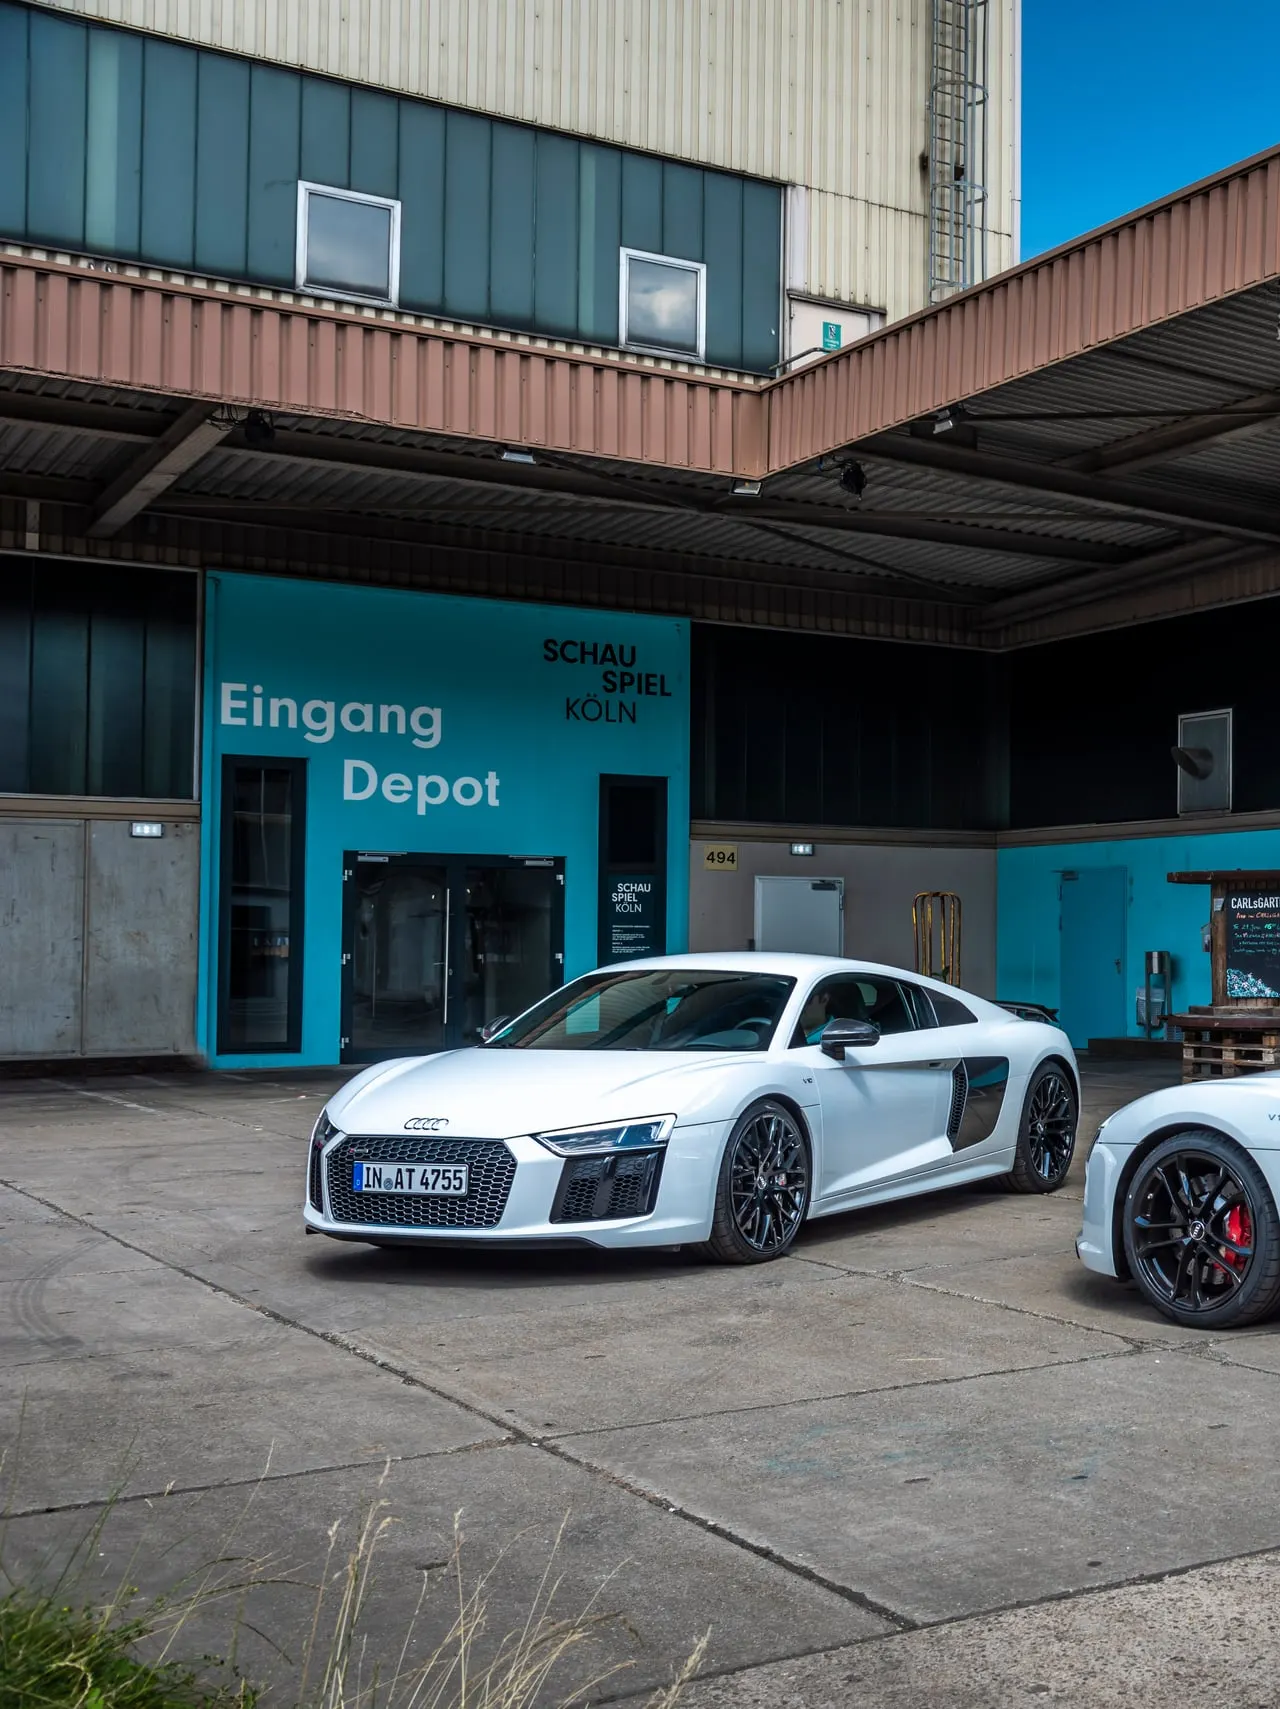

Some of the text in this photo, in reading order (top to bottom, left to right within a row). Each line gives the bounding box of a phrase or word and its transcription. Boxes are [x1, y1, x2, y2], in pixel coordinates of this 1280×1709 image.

[543, 638, 636, 668] SCHAU
[602, 670, 672, 697] SPIEL
[220, 682, 442, 749] Eingang
[565, 693, 637, 724] KÖLN
[343, 759, 500, 816] Depot
[706, 851, 736, 865] 494
[611, 893, 638, 902] SPIEL
[617, 883, 651, 893] SCHAU
[615, 902, 642, 913] KÖLN
[364, 1167, 463, 1191] IN AT 4755
